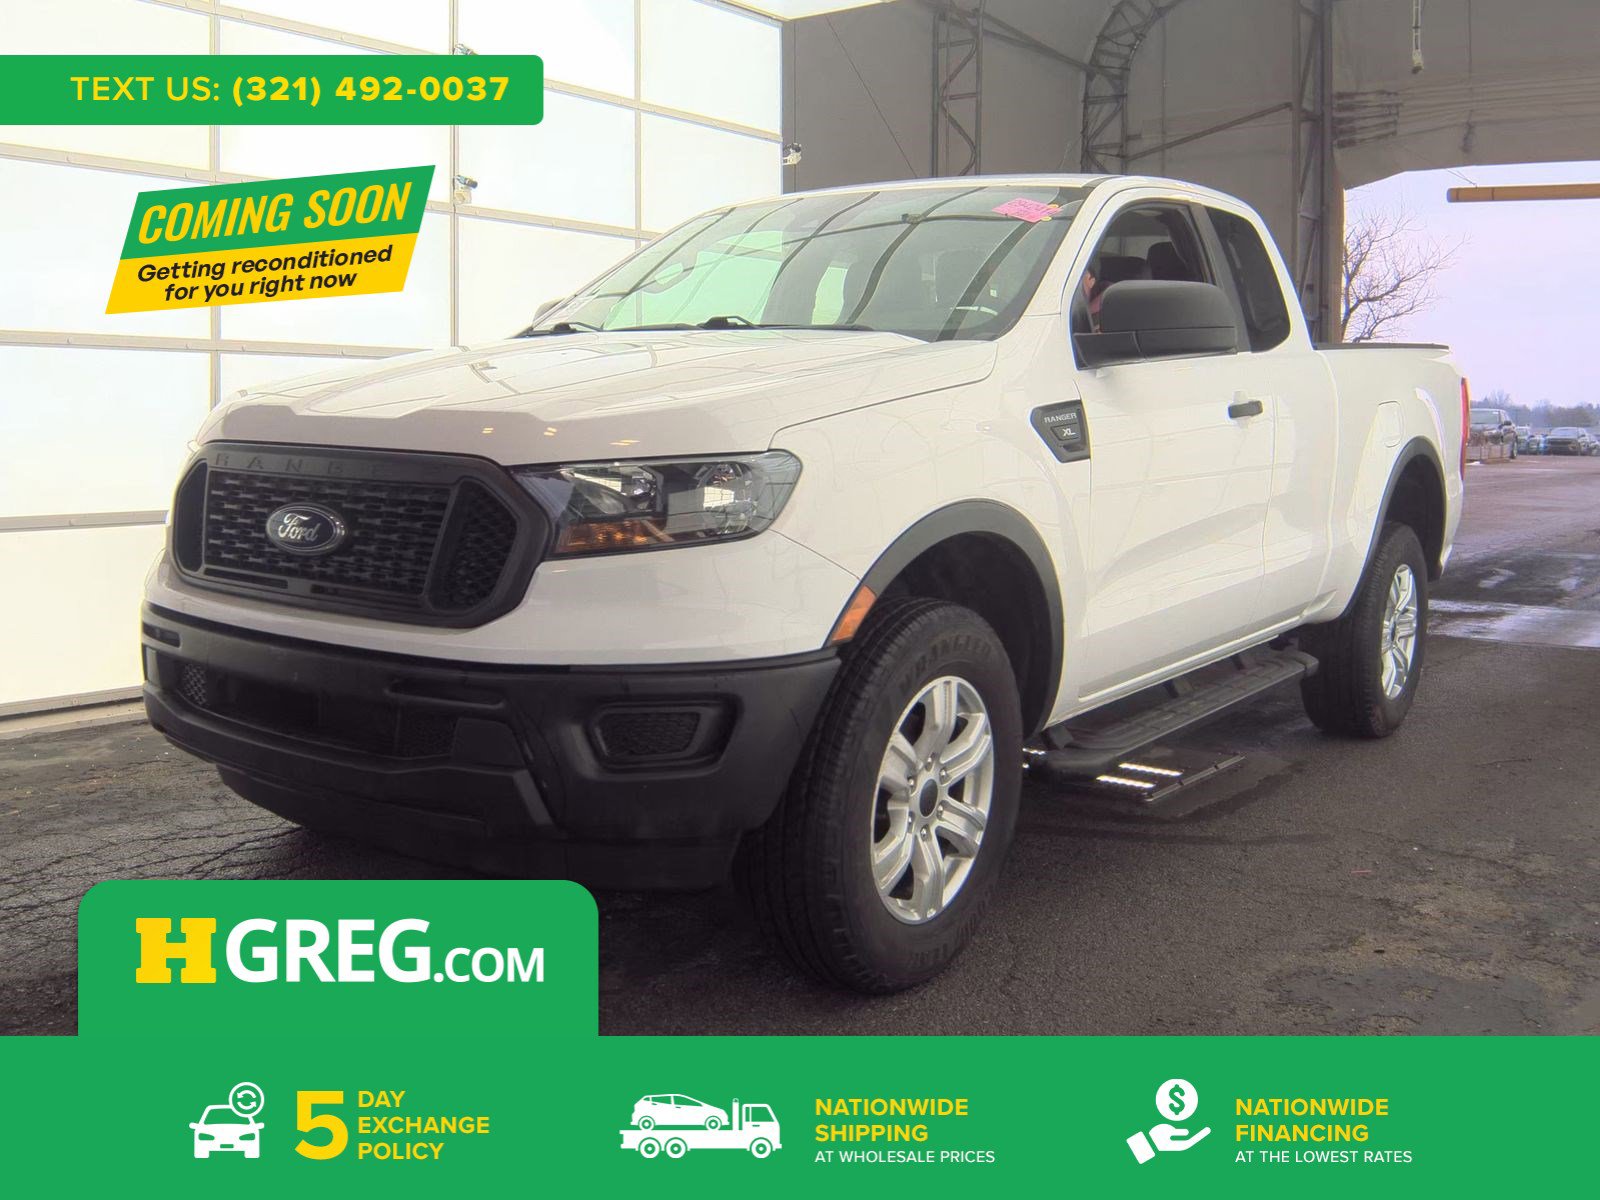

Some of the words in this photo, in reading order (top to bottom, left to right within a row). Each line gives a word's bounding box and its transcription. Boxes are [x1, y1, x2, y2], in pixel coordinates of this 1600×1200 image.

[1044, 412, 1078, 424] RANGER
[1062, 427, 1077, 437] XL
[278, 512, 322, 542] Ford
